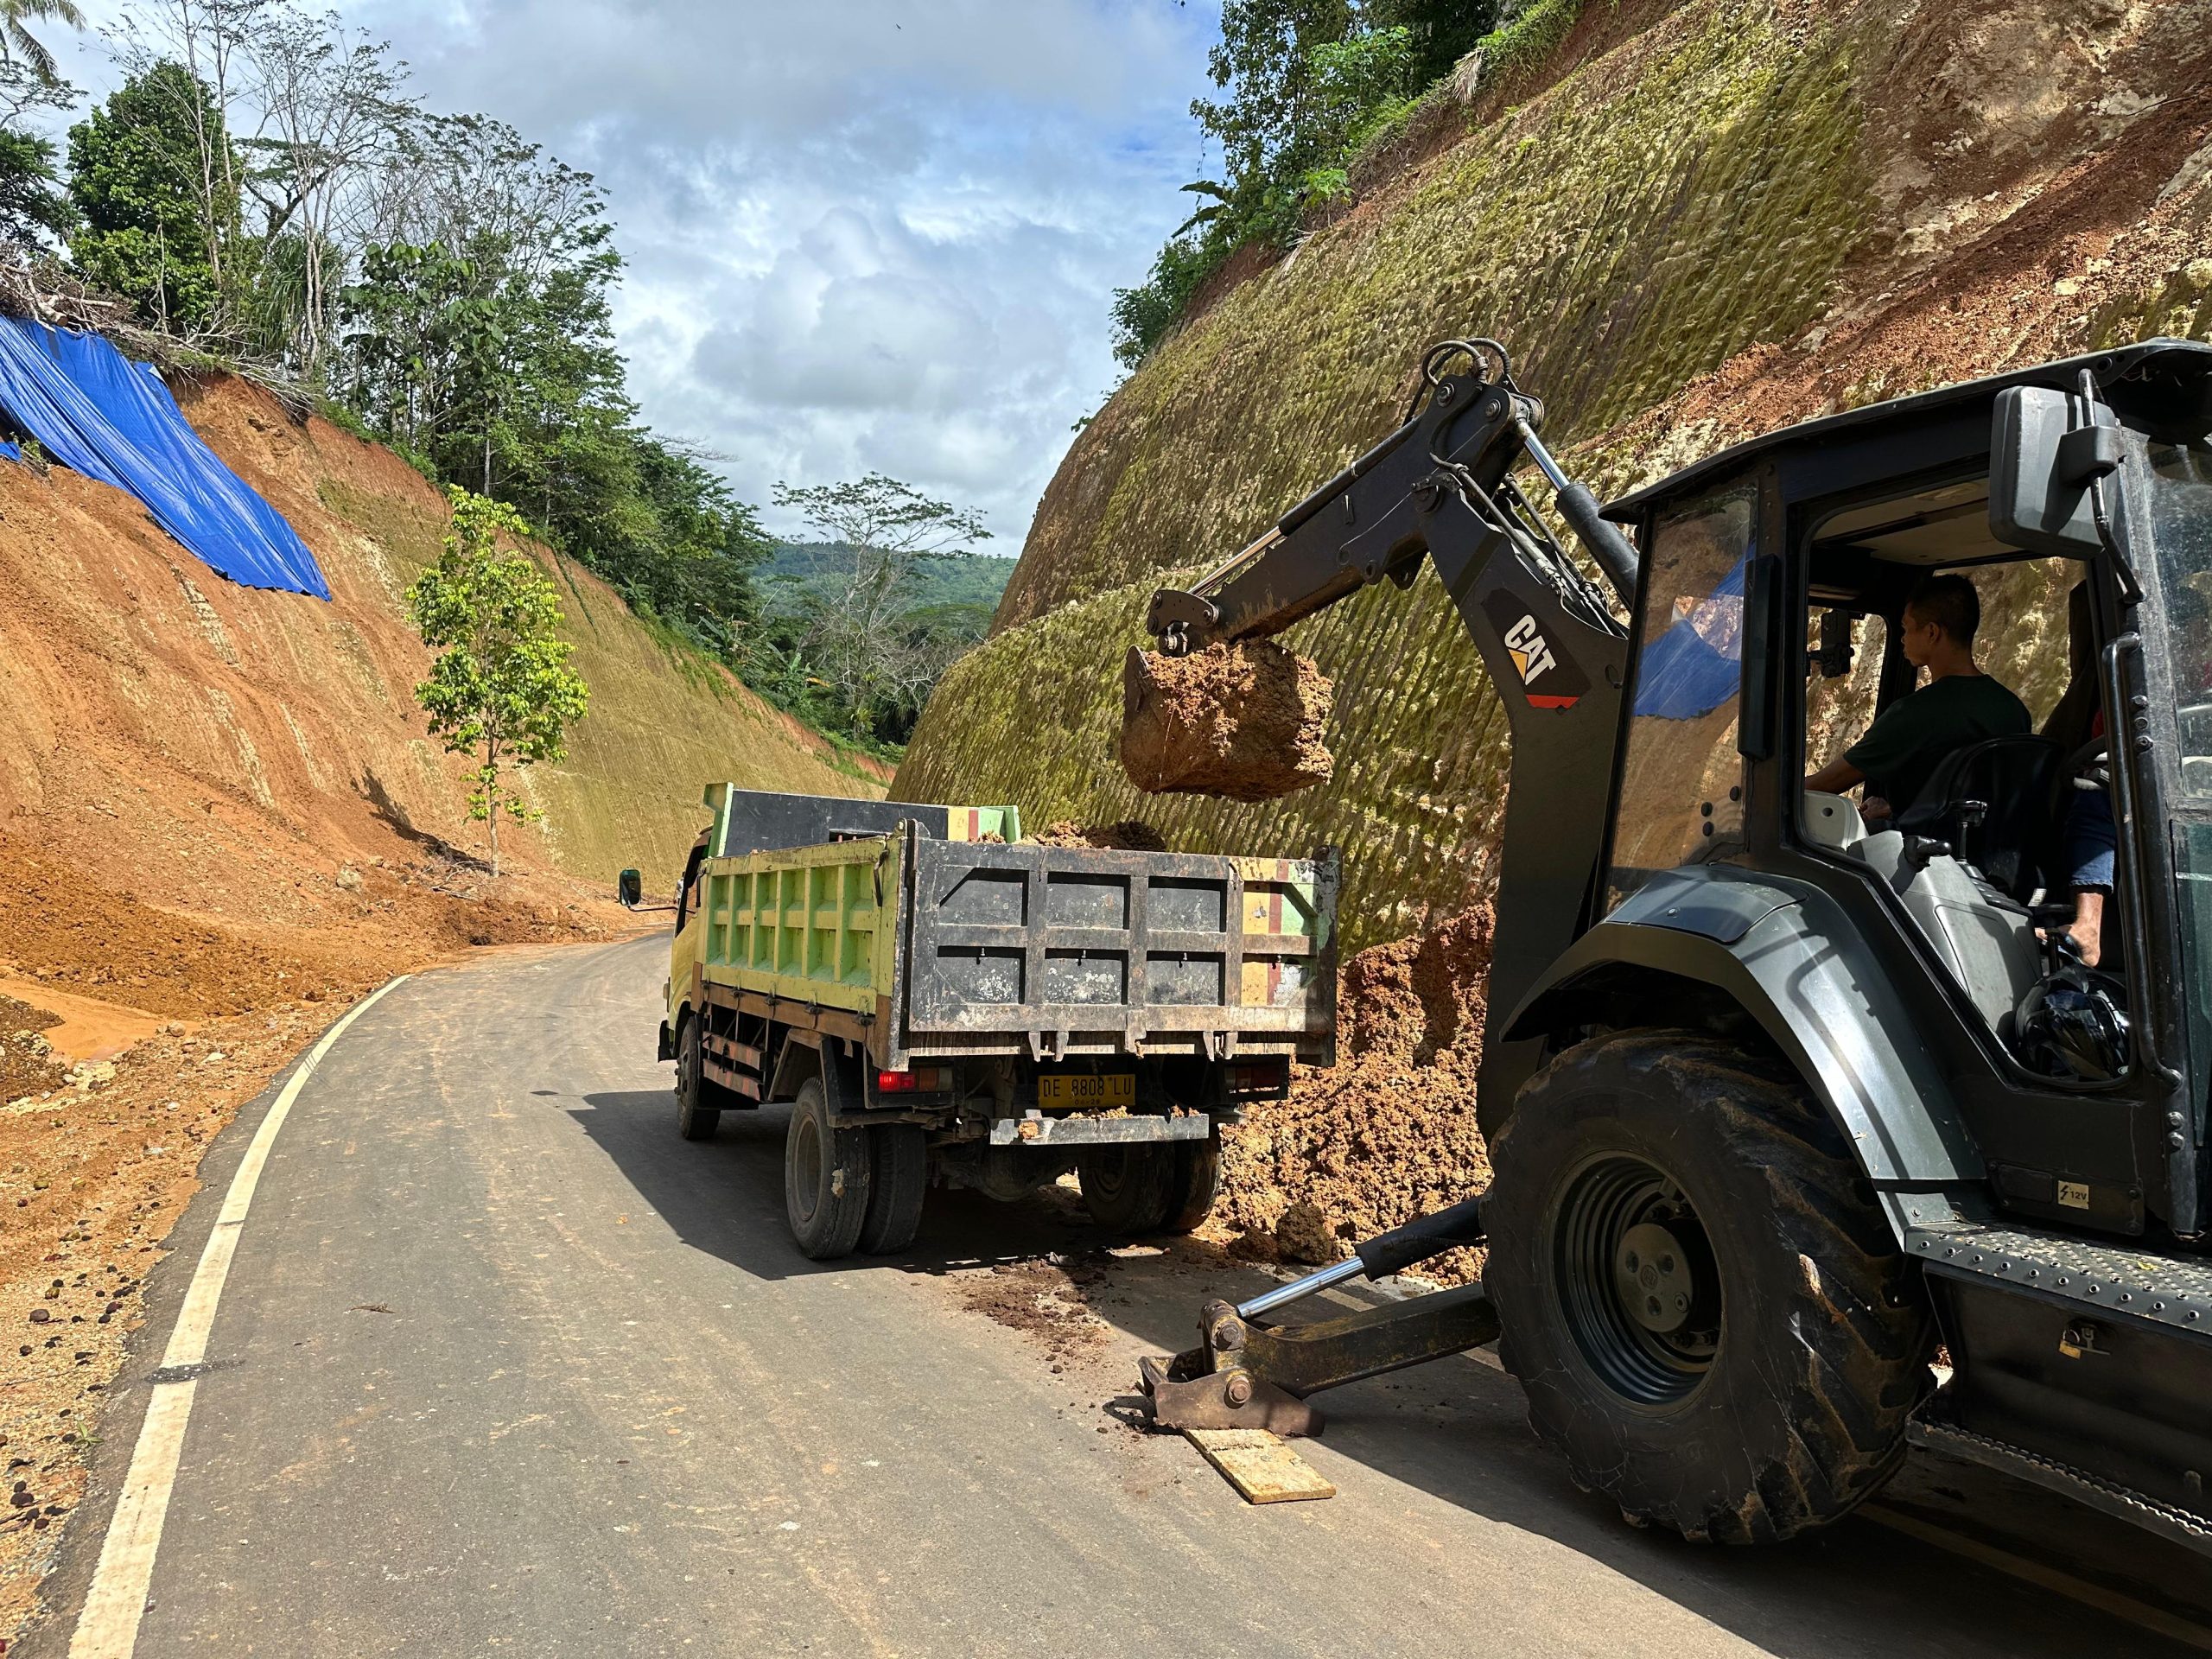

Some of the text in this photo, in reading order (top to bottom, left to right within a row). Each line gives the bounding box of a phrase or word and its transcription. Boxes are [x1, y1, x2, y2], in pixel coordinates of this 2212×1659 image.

[1503, 614, 1557, 686] CAT
[1043, 1078, 1060, 1097] DE
[1113, 1077, 1131, 1096] LU
[2069, 1191, 2088, 1200] 12V
